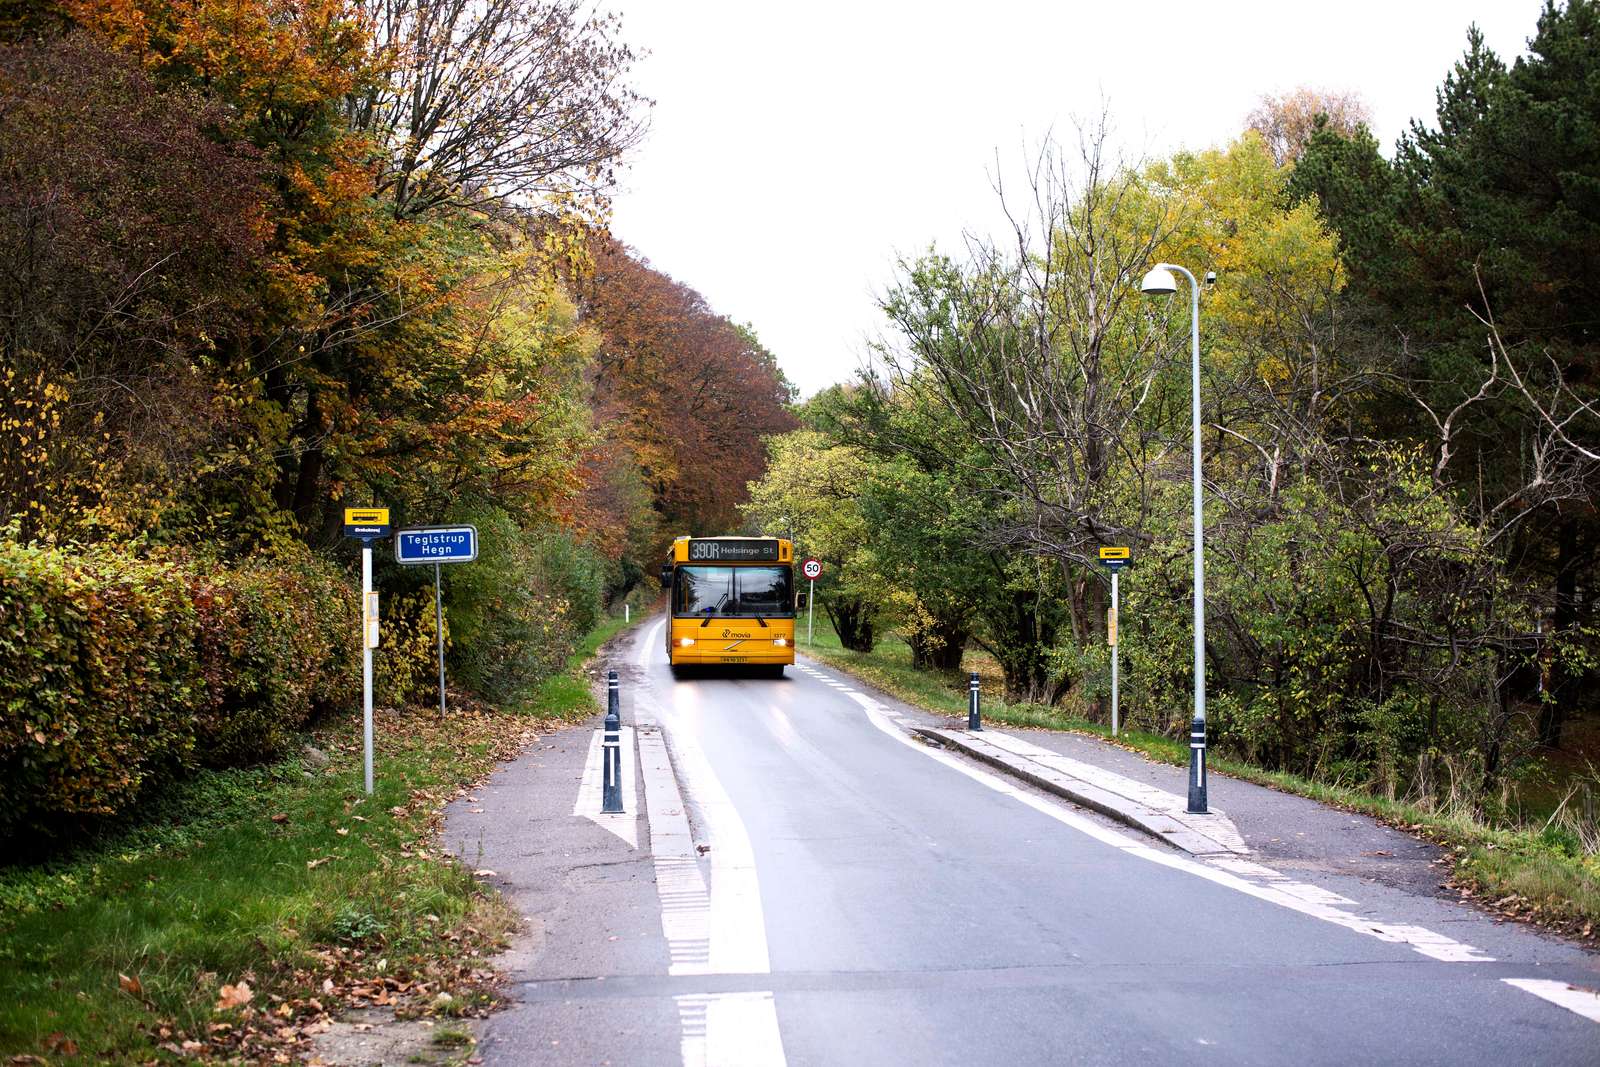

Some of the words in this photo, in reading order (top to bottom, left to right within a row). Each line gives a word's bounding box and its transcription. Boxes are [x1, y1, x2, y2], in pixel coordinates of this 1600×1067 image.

[407, 534, 465, 545] Teglstrup
[422, 545, 452, 555] Hegn
[692, 542, 720, 559] 390R
[721, 547, 760, 555] Helsinge
[806, 564, 819, 572] 50
